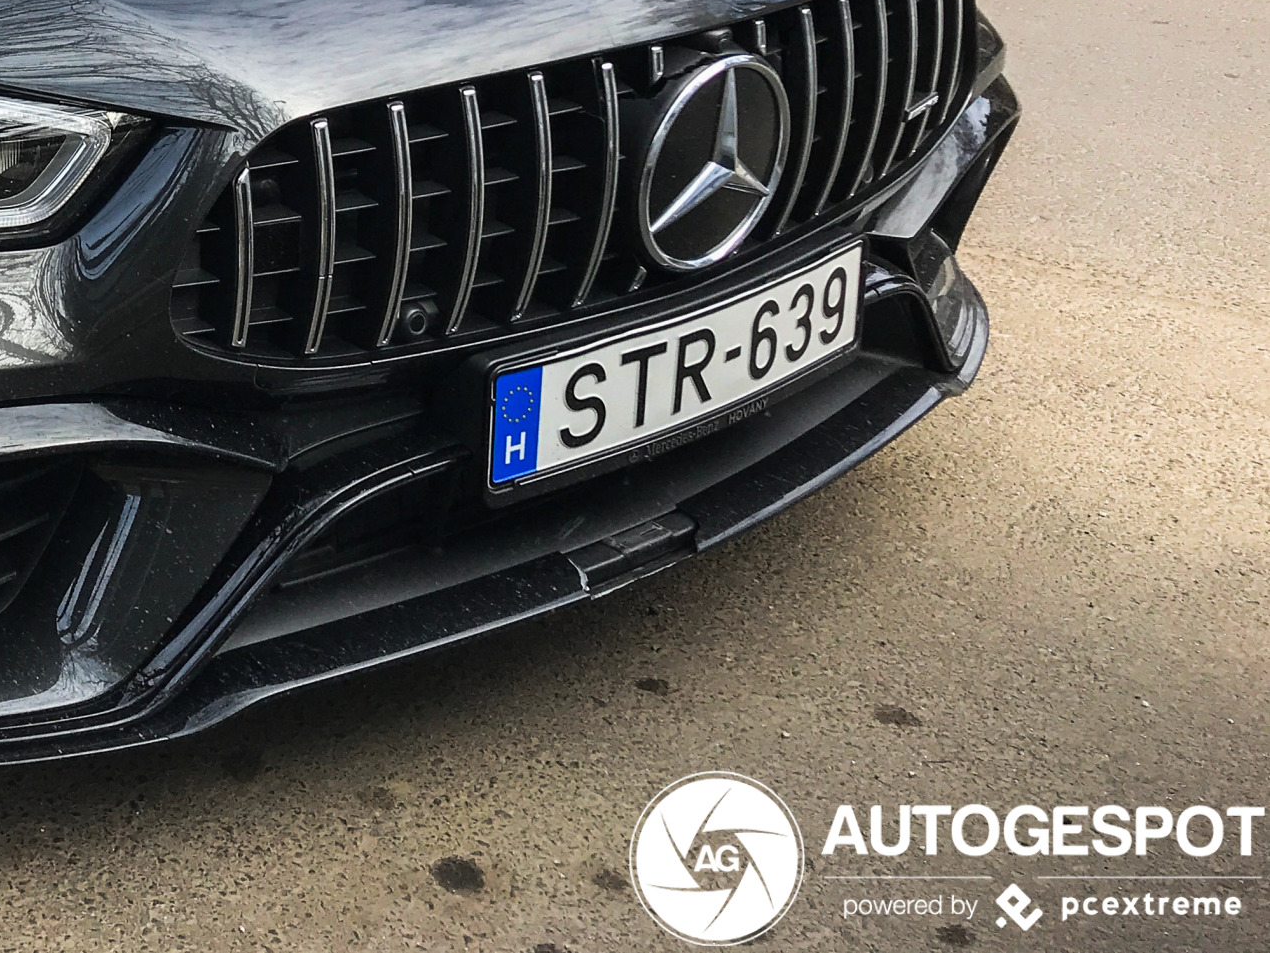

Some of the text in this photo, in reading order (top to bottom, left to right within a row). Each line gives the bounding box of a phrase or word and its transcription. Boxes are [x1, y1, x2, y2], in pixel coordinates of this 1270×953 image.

[559, 266, 848, 450] STR-639
[504, 431, 526, 465] H
[645, 420, 720, 458] Mercedes-Benz
